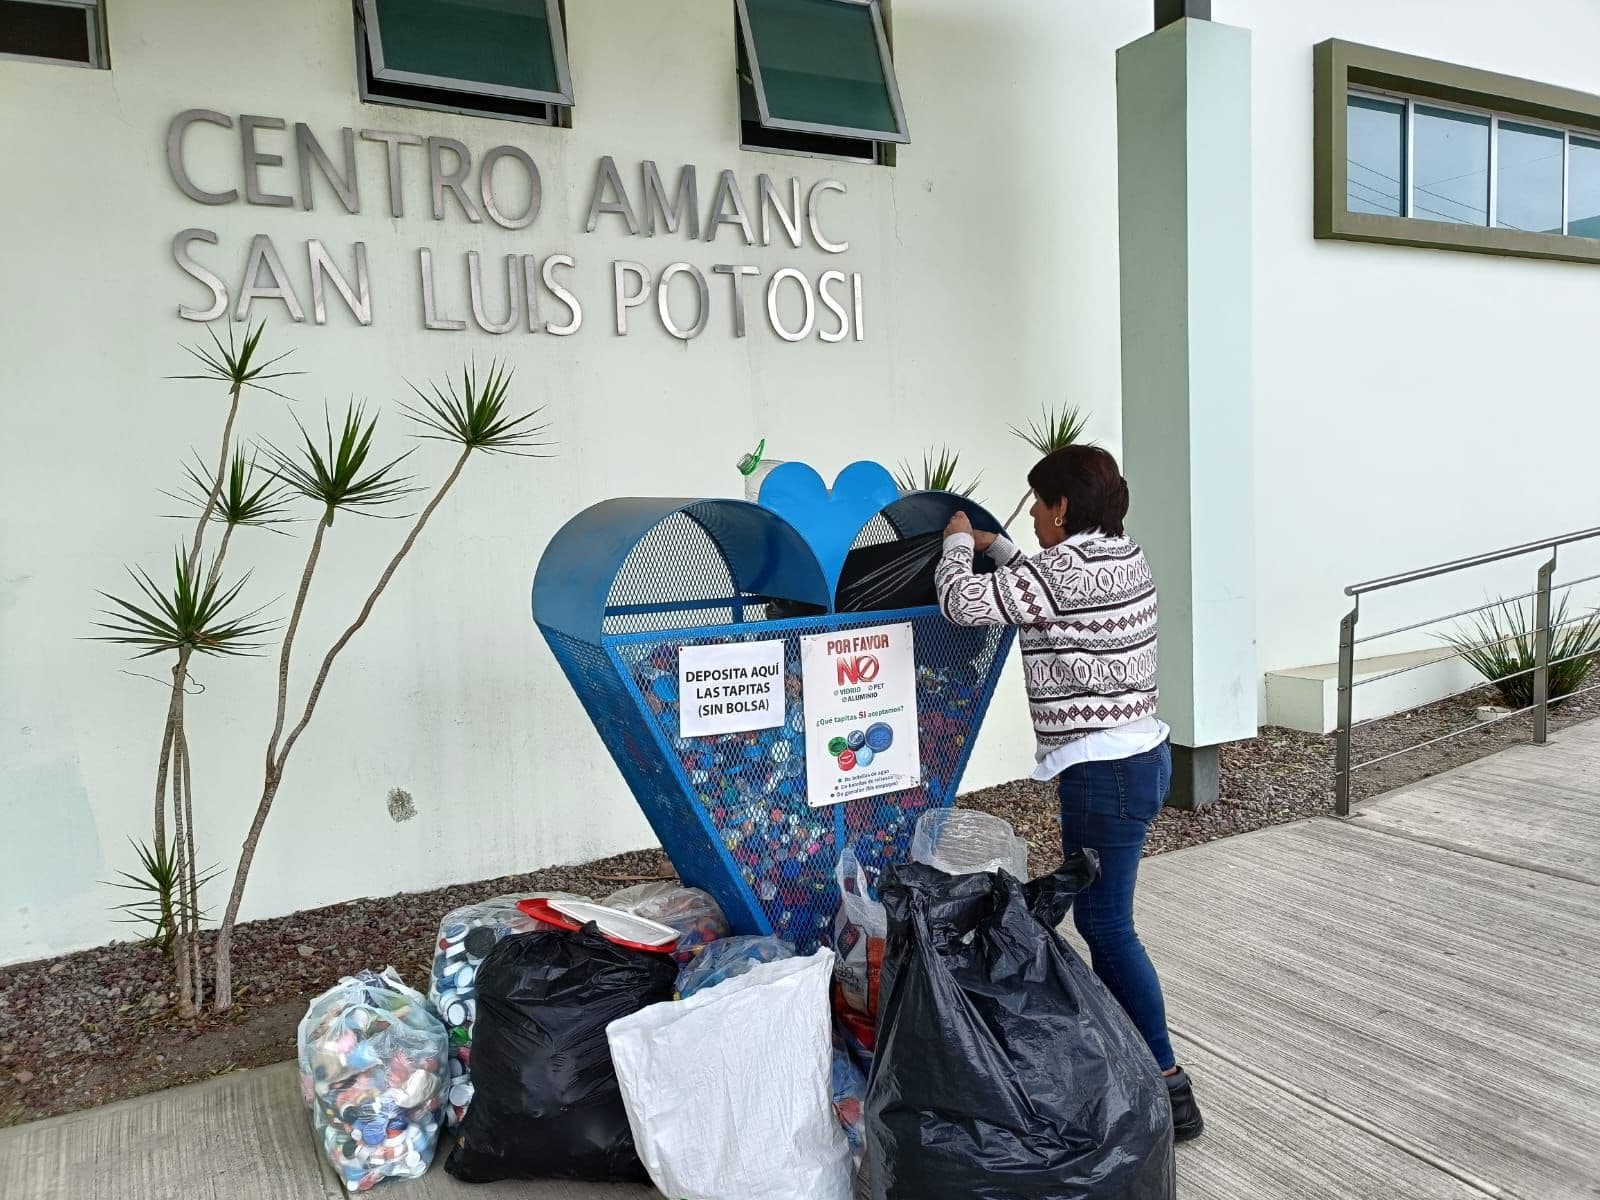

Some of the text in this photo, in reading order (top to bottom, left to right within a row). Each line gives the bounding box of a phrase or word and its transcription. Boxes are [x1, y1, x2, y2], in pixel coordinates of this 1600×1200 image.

[166, 108, 849, 254] CENTRO AMANC
[172, 227, 864, 343] SAN LUIS POTOSI
[827, 634, 889, 655] POR FAVOR
[685, 662, 779, 683] DEPOSITA AQUÍ
[836, 655, 880, 686] NO
[696, 682, 771, 699] LAS TAPITAS
[839, 686, 862, 695] VIDRIO
[847, 692, 878, 702] ALUMINIO
[698, 698, 770, 718] (SIN BOLSA)
[834, 714, 857, 722] tapitas
[867, 706, 904, 717] aceptamos?
